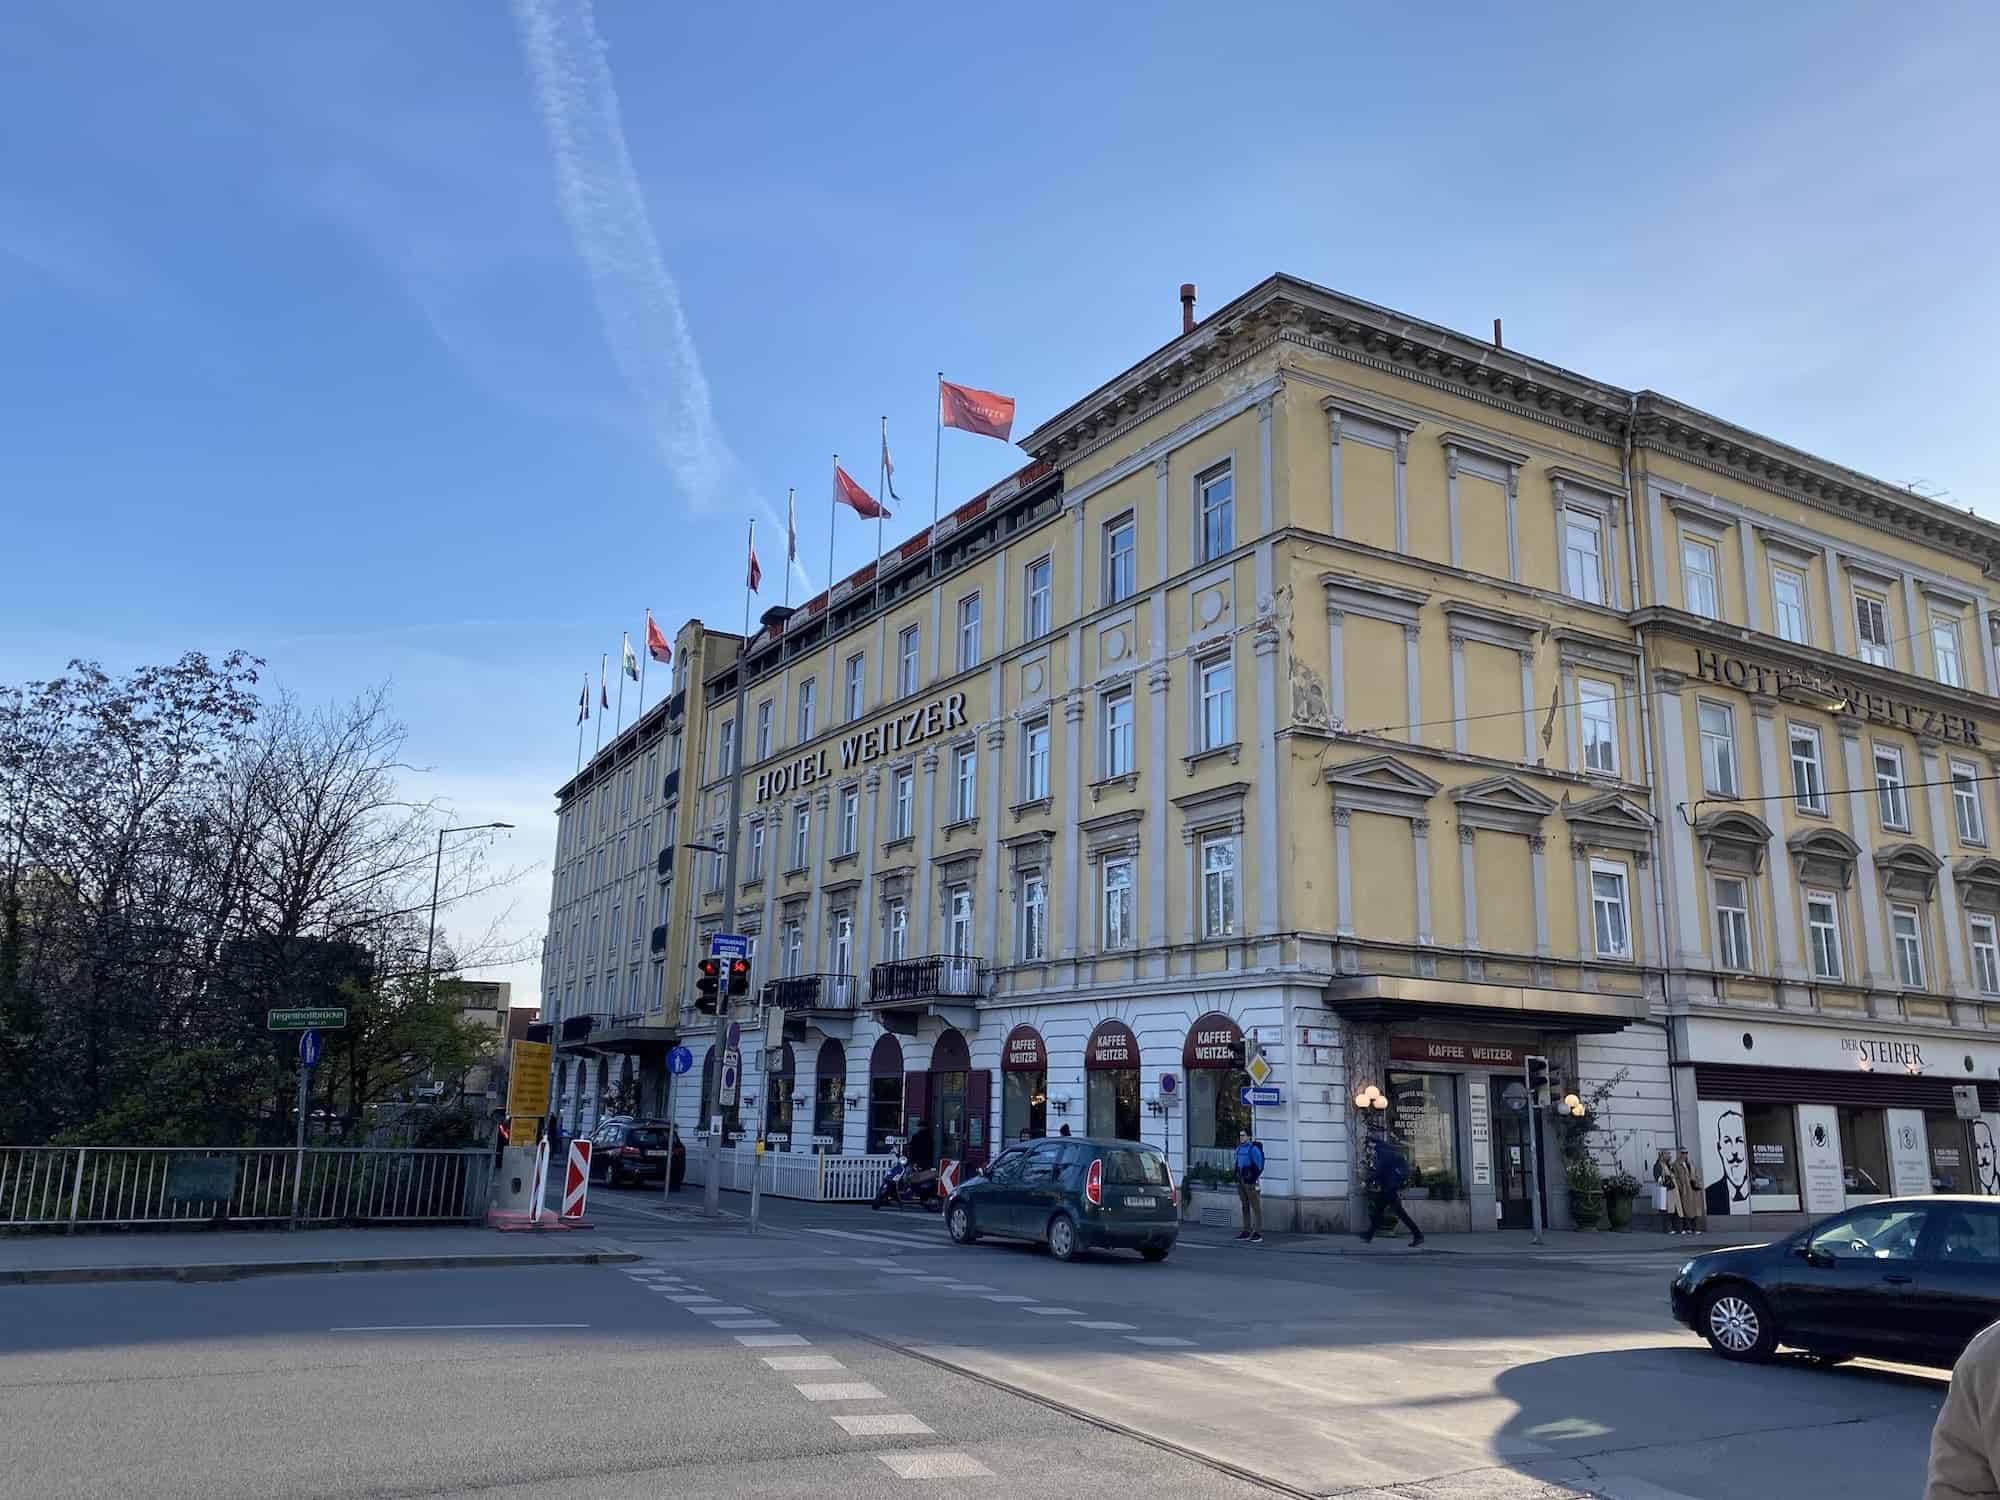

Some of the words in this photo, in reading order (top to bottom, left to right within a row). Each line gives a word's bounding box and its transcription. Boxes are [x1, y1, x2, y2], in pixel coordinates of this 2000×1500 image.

[1832, 685, 1982, 747] WEITZER
[755, 750, 832, 803] HOTEL
[839, 692, 968, 770] WEITZER
[1096, 1033, 1126, 1047] KAFFEE
[1197, 1030, 1232, 1044] KAFFEE
[1011, 1039, 1036, 1051] KAFFEE
[1428, 1043, 1465, 1058] KAFFEE
[1471, 1047, 1513, 1060] WEITZER
[1009, 1051, 1038, 1064] WEITZER
[1095, 1048, 1128, 1062] WEITZER
[1841, 1038, 1858, 1051] DER
[1859, 1039, 1925, 1069] STEIRER
